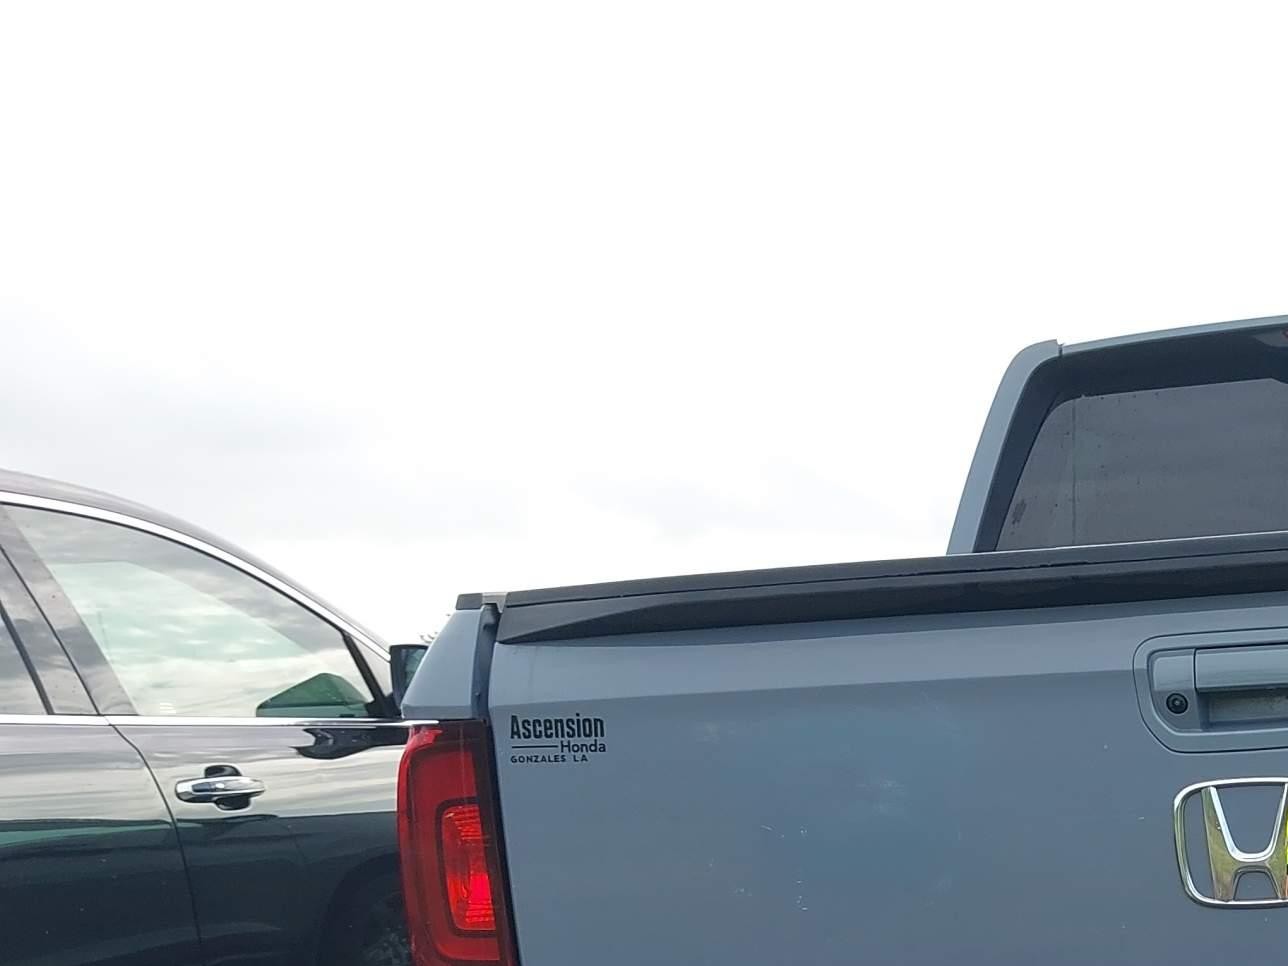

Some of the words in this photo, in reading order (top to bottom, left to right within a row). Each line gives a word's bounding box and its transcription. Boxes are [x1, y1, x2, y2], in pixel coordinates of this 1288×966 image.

[510, 712, 605, 739] Ascension
[560, 739, 607, 753] Honda
[510, 754, 567, 763] GONZALES
[573, 754, 589, 763] LA
